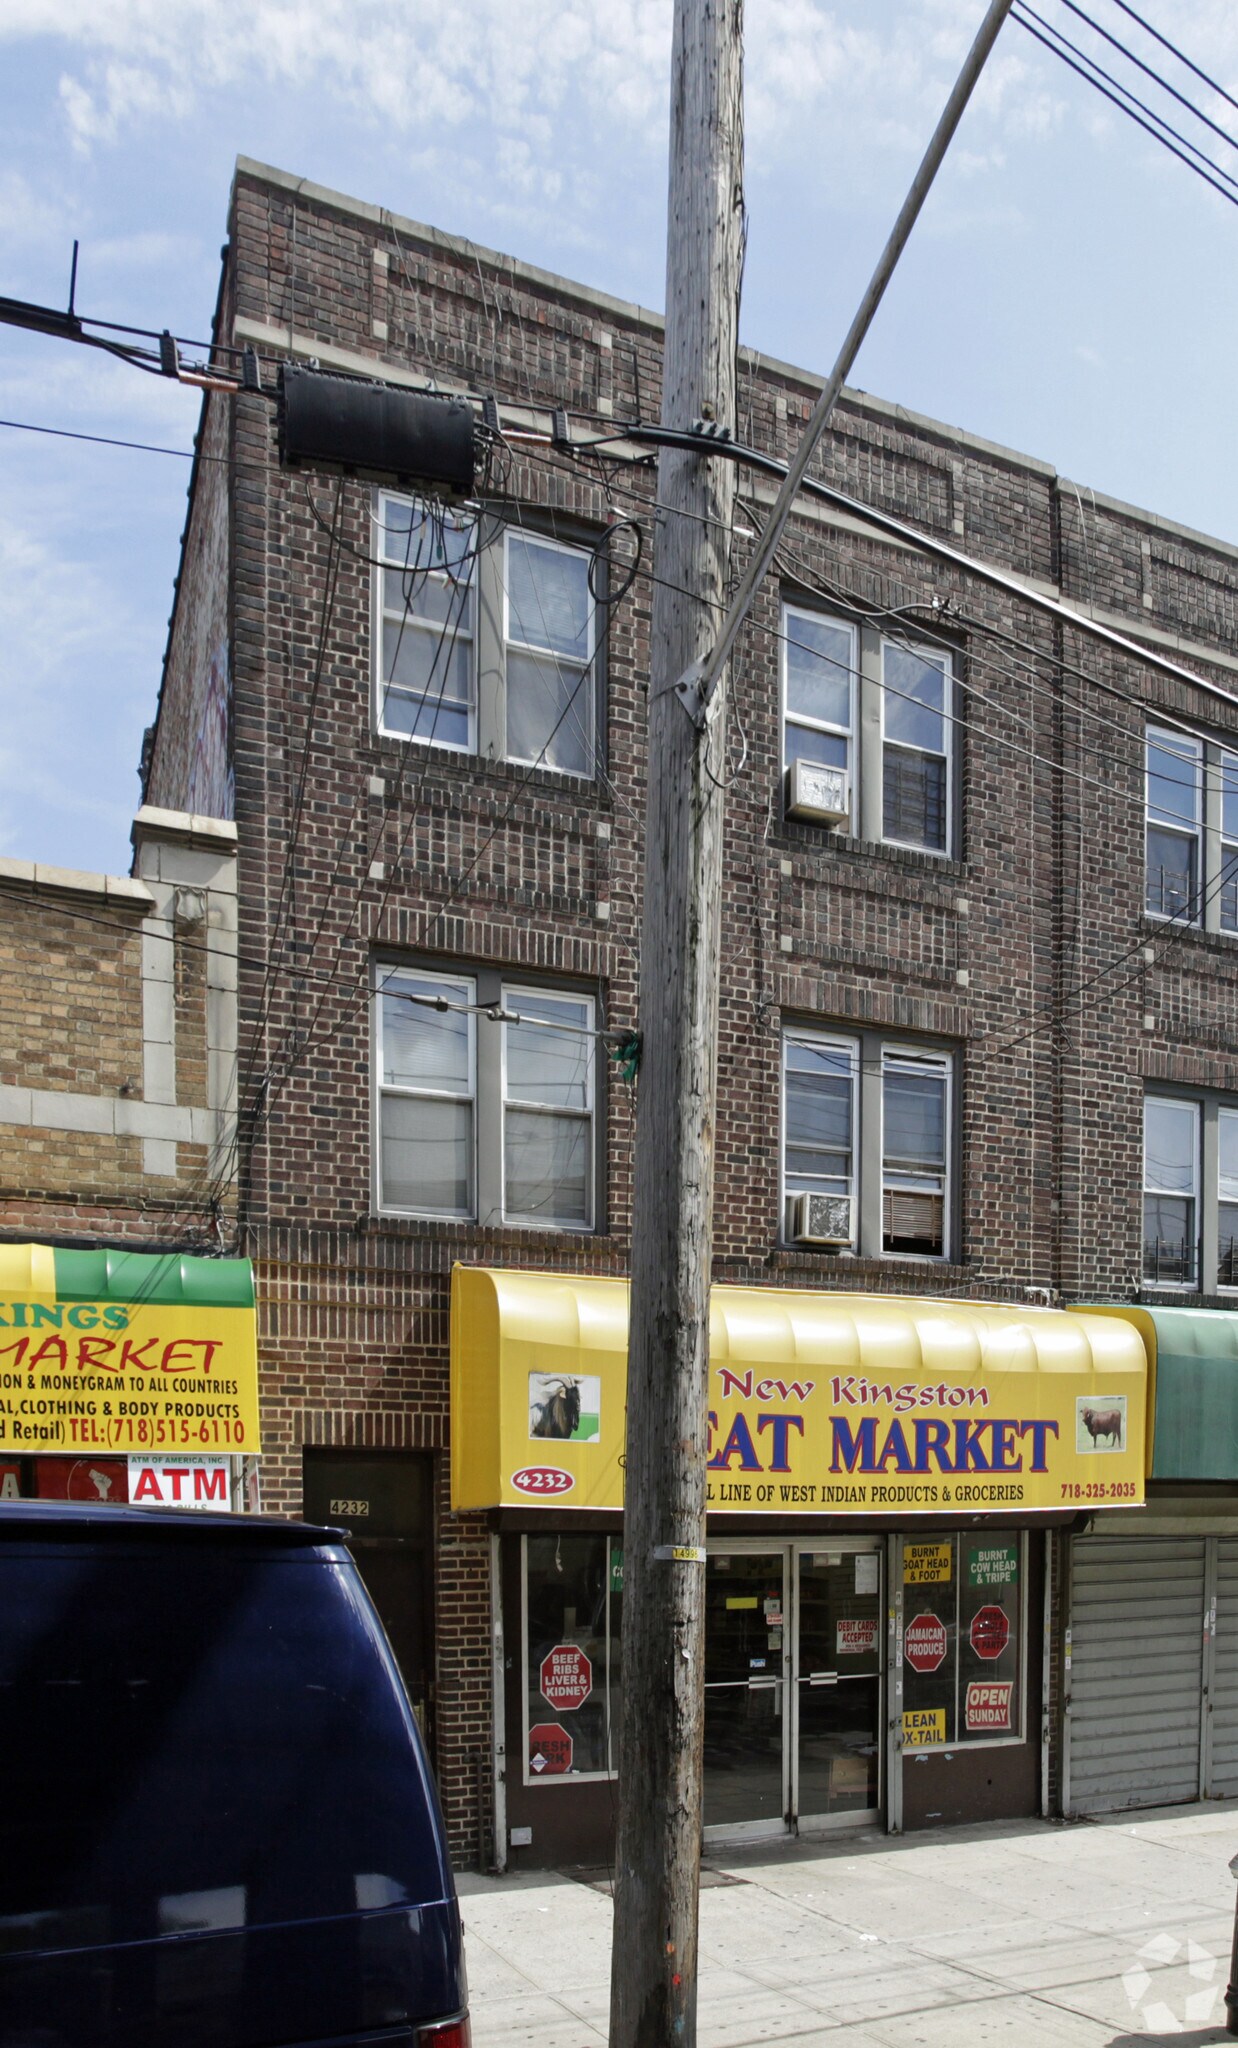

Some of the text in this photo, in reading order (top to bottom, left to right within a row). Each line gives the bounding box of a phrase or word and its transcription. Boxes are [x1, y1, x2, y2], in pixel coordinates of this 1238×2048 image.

[27, 1375, 36, 1389] &
[41, 1375, 125, 1391] MONEYGRAM
[129, 1377, 144, 1391] TO
[149, 1378, 168, 1392] ALL
[173, 1378, 238, 1394] COUNTRIES
[717, 1367, 989, 1412] New Kingston
[103, 1401, 112, 1415] &
[119, 1402, 158, 1416] BODY
[165, 1402, 240, 1418] PRODUCTS
[13, 1420, 65, 1444] Retail)
[828, 1416, 1059, 1473] MARKET
[165, 1457, 206, 1465] AMERICA,
[133, 1468, 227, 1501] ATM
[516, 1471, 567, 1489] 4232
[720, 1484, 752, 1501] LINE
[756, 1485, 775, 1501] OF
[779, 1485, 816, 1502] WEST
[821, 1485, 866, 1502] INDIAN
[871, 1485, 938, 1502] PRODUCTS
[942, 1485, 951, 1501] &
[955, 1484, 1024, 1501] GROCERIES
[1061, 1482, 1136, 1499] 718-325-2035
[331, 1501, 367, 1514] 4232
[911, 1547, 940, 1558] BURNT
[978, 1549, 1008, 1562] BURNT
[927, 1558, 949, 1569] HEAD
[970, 1560, 1017, 1573] COW HEAD
[911, 1570, 941, 1581] & FOOT
[976, 1571, 1011, 1584] & TRIPE
[837, 1620, 878, 1632] DEBIT CARDS
[842, 1632, 874, 1643] ACCEPTED
[906, 1627, 943, 1640] JAMAICAN
[907, 1642, 944, 1656] PRODUCE
[551, 1654, 580, 1664] BEEF
[553, 1664, 579, 1675] RIBS
[545, 1674, 587, 1686] LIVER &
[546, 1685, 588, 1697] KIDNEY
[969, 1688, 1008, 1706] OPEN
[905, 1713, 937, 1728] LEAN
[969, 1708, 1006, 1723] SUNDAY
